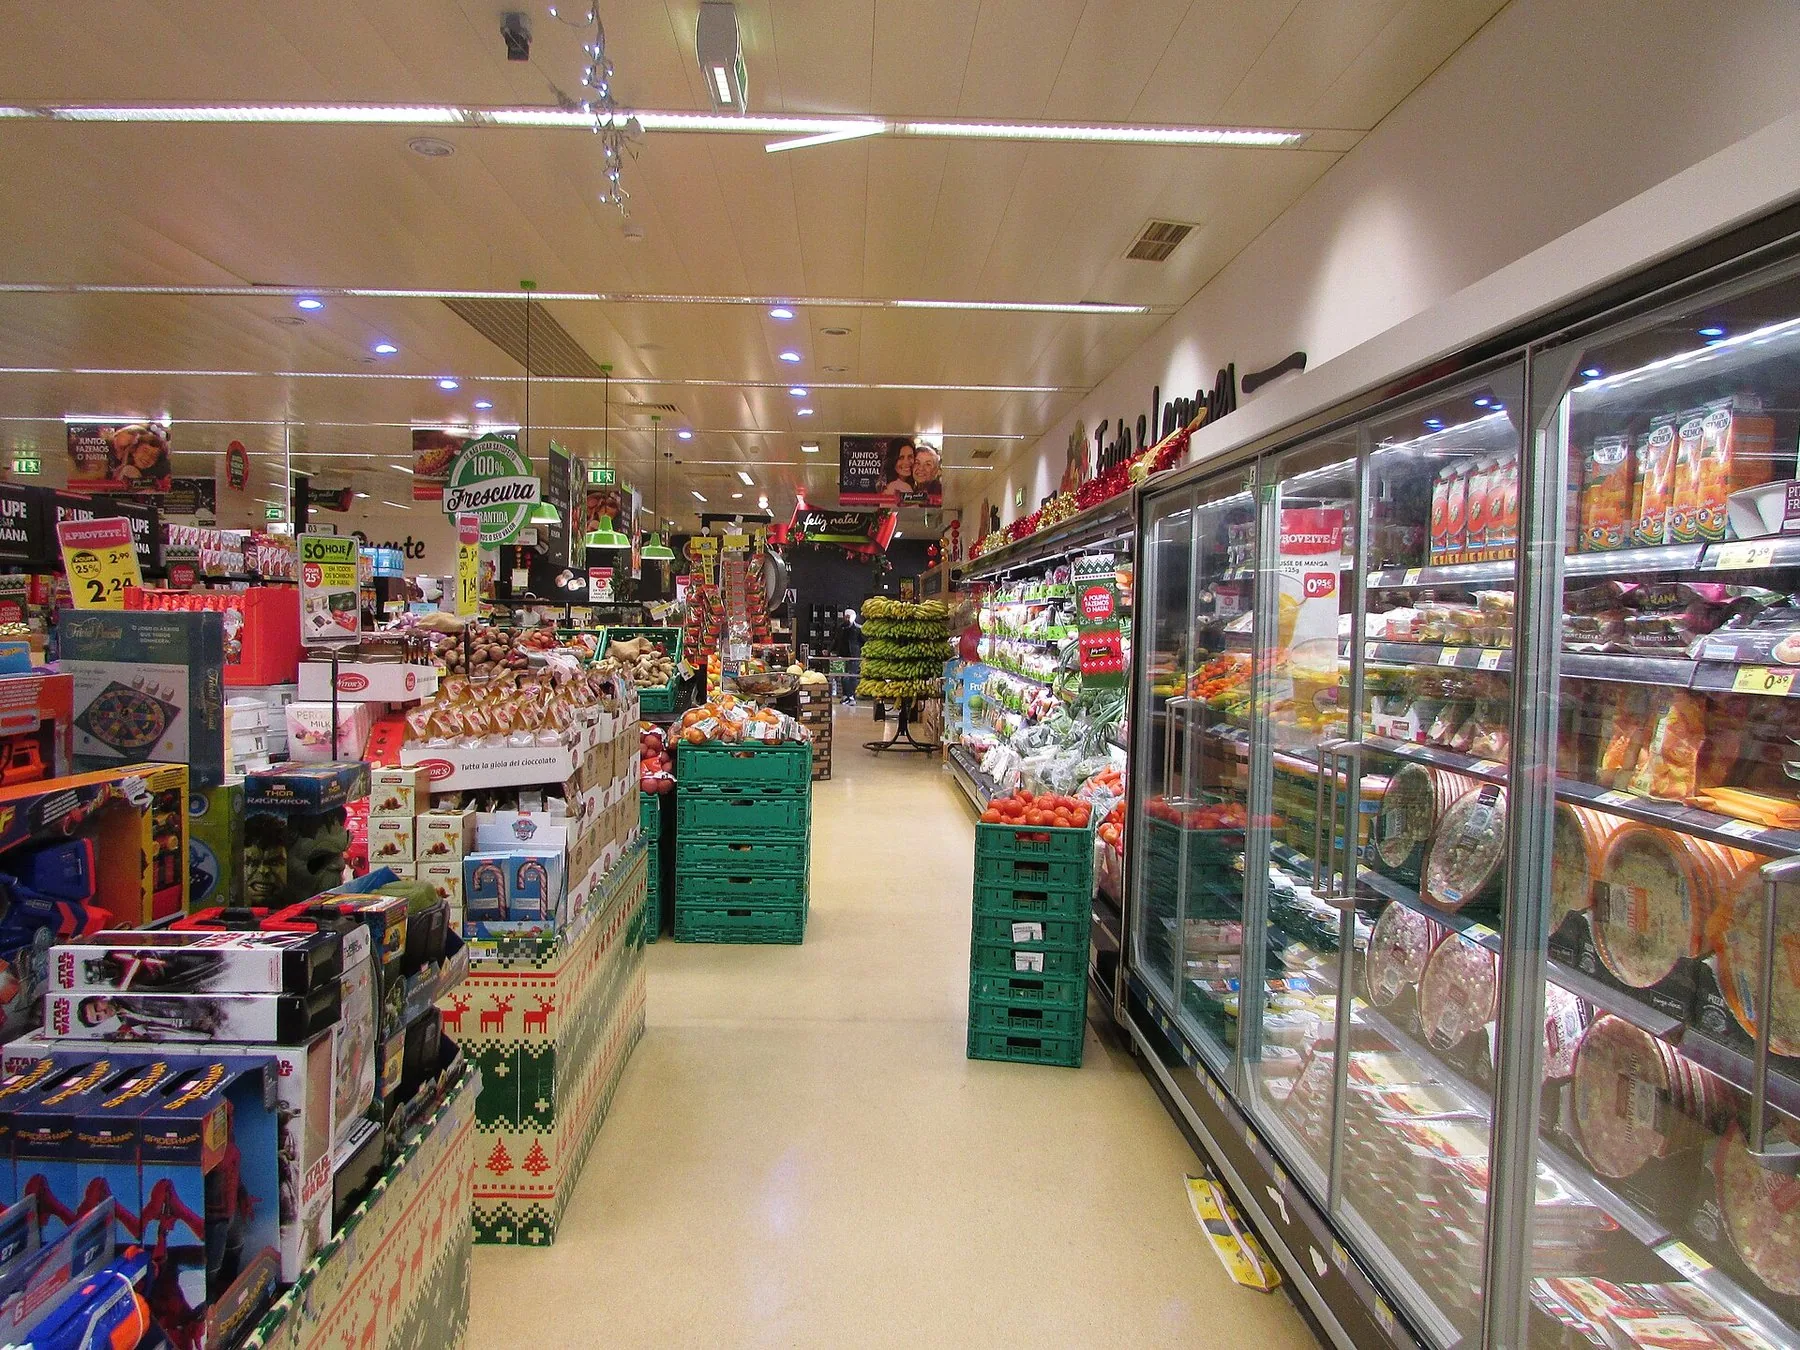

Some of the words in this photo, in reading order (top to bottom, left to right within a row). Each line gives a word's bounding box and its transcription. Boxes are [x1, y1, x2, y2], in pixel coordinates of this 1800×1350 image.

[78, 437, 107, 446] JUNTOS
[851, 451, 879, 460] JUNTOS
[473, 455, 505, 476] 100%
[848, 459, 881, 468] FAZEMOS
[849, 467, 857, 475] O
[858, 467, 880, 475] NATAL
[447, 482, 535, 511] Frescura
[803, 512, 827, 532] feliz
[829, 513, 859, 525] natal
[65, 522, 128, 541] APROVEITE!
[308, 525, 317, 533] 03
[304, 539, 325, 559] SÓ
[109, 552, 130, 563] 2,99
[76, 564, 100, 574] 25%
[305, 573, 320, 583] 25%
[1088, 593, 1110, 601] POUPAR
[310, 720, 331, 728] MILK
[461, 763, 480, 771] Tutta
[509, 760, 520, 768] del
[521, 756, 557, 766] cioccolato
[246, 797, 311, 805] RAGNAROK
[65, 952, 75, 989] WARS
[53, 998, 62, 1036] STAR
[61, 998, 71, 1036] WARS
[305, 1154, 331, 1187] STAR
[302, 1166, 331, 1206] WARS
